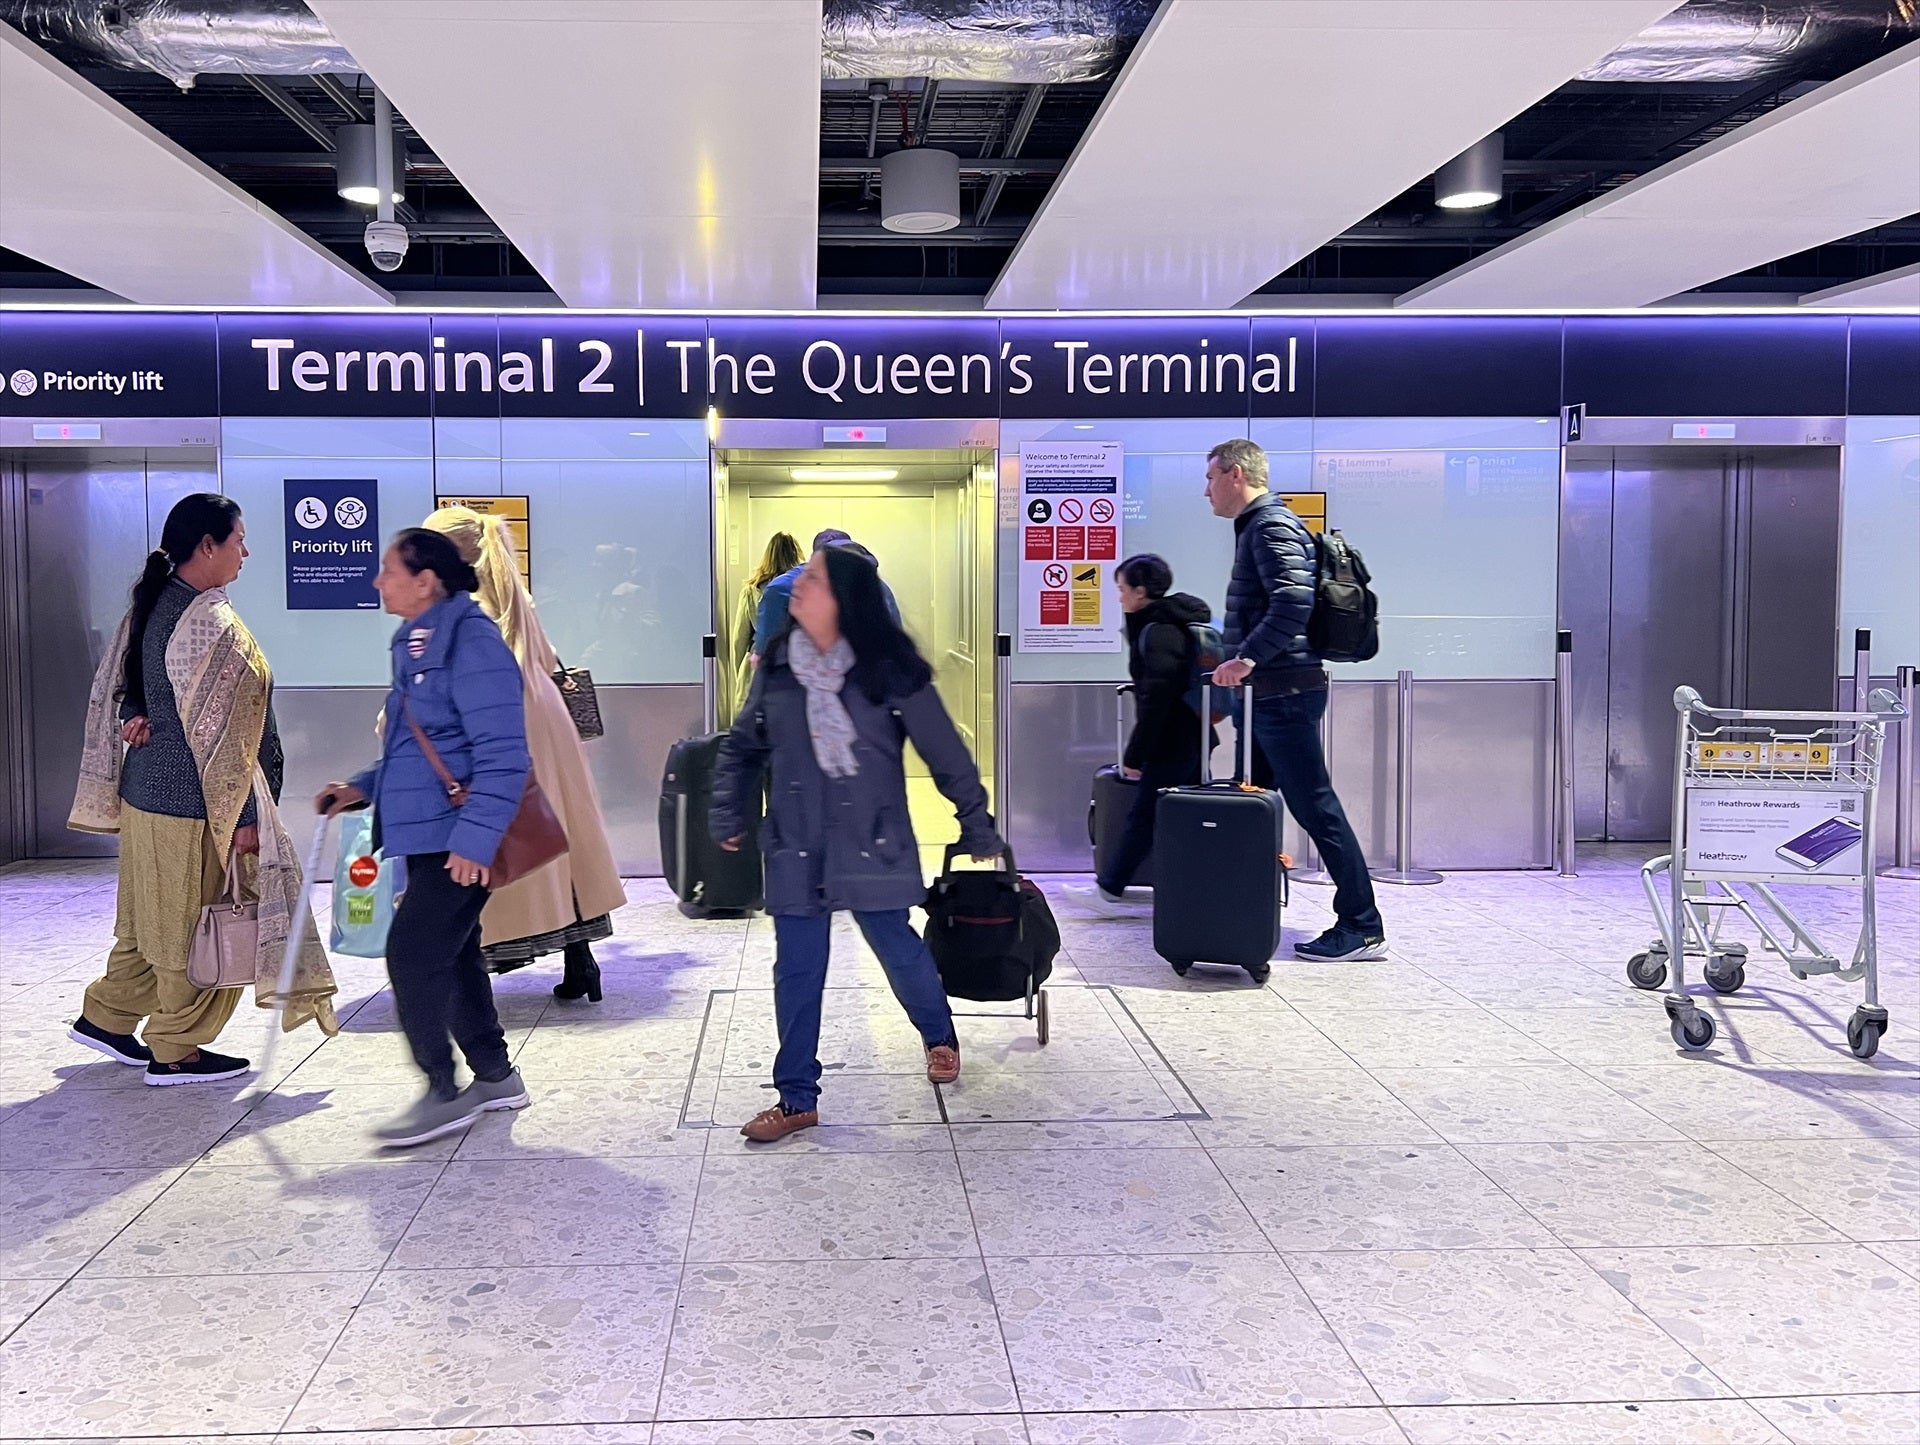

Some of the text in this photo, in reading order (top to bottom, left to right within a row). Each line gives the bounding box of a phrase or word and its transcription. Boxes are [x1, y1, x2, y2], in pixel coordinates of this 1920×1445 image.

[251, 337, 615, 393] Terminal 2
[666, 337, 1297, 403] The Queen's Terminal
[43, 371, 164, 395] Priority lift
[292, 540, 373, 556] Priority lift
[1717, 800, 1761, 808] Heathrow
[1762, 801, 1801, 809] Rewards
[1698, 852, 1748, 861] Heathrow
